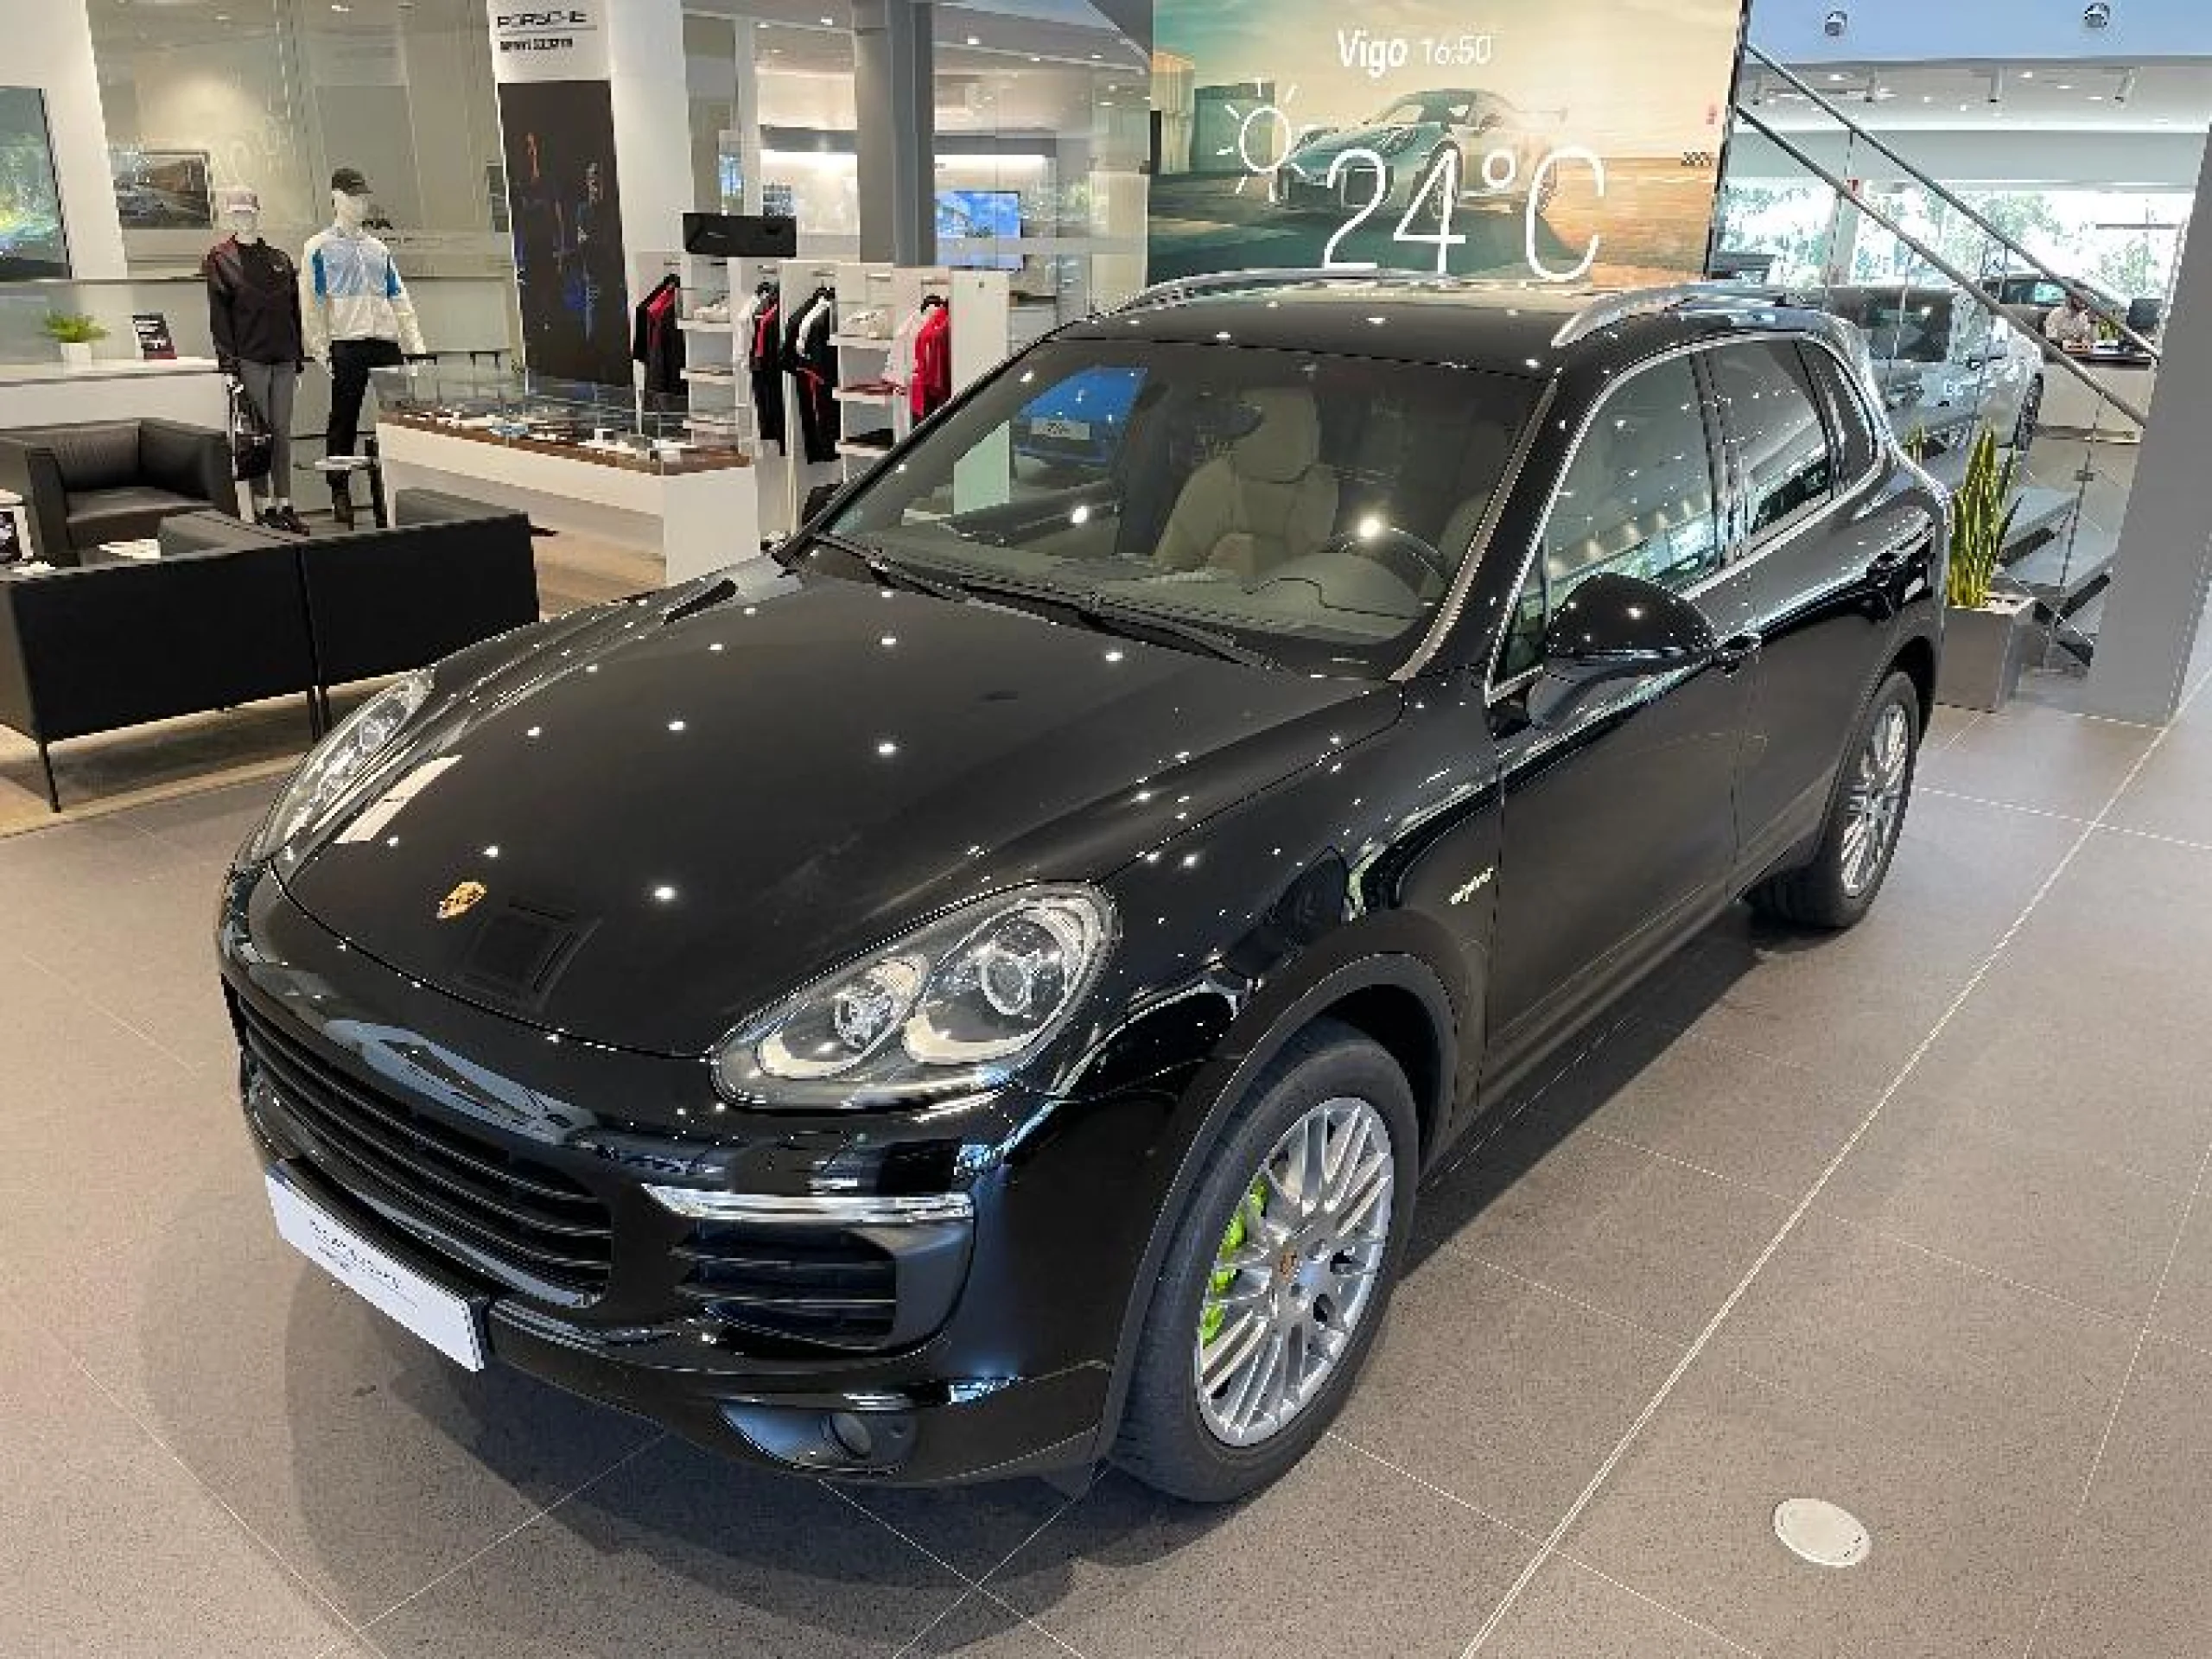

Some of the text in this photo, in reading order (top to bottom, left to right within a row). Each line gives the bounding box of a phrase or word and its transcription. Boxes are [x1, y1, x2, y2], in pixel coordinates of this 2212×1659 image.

[1338, 29, 1492, 78] Vigo 16:50
[1324, 148, 1605, 283] 24°C
